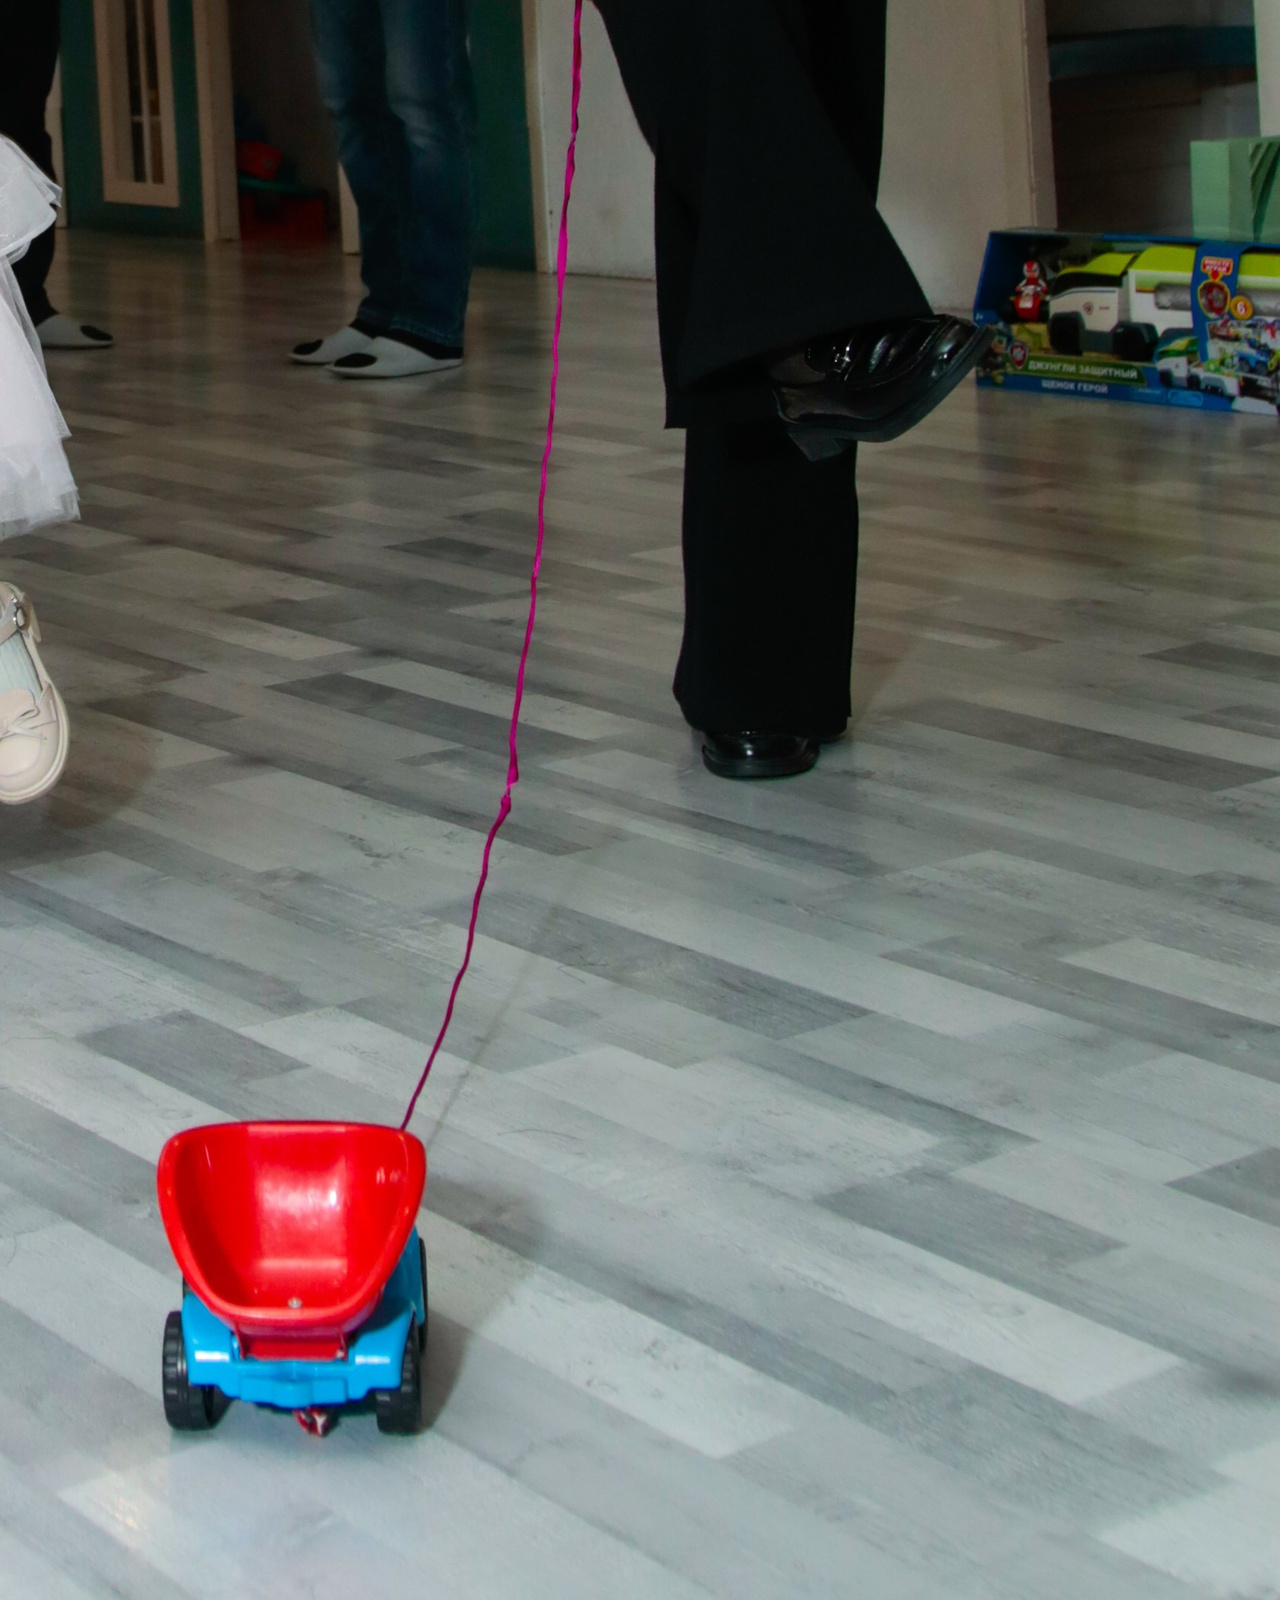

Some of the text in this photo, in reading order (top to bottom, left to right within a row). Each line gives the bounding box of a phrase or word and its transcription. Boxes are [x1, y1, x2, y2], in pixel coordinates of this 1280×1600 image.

[1236, 301, 1246, 315] 6
[1028, 360, 1138, 379] ДЖУНГЛИ ЗАЩИТНЫЙ
[1041, 379, 1108, 394] ЩЕНОК ГЕРОЙ
